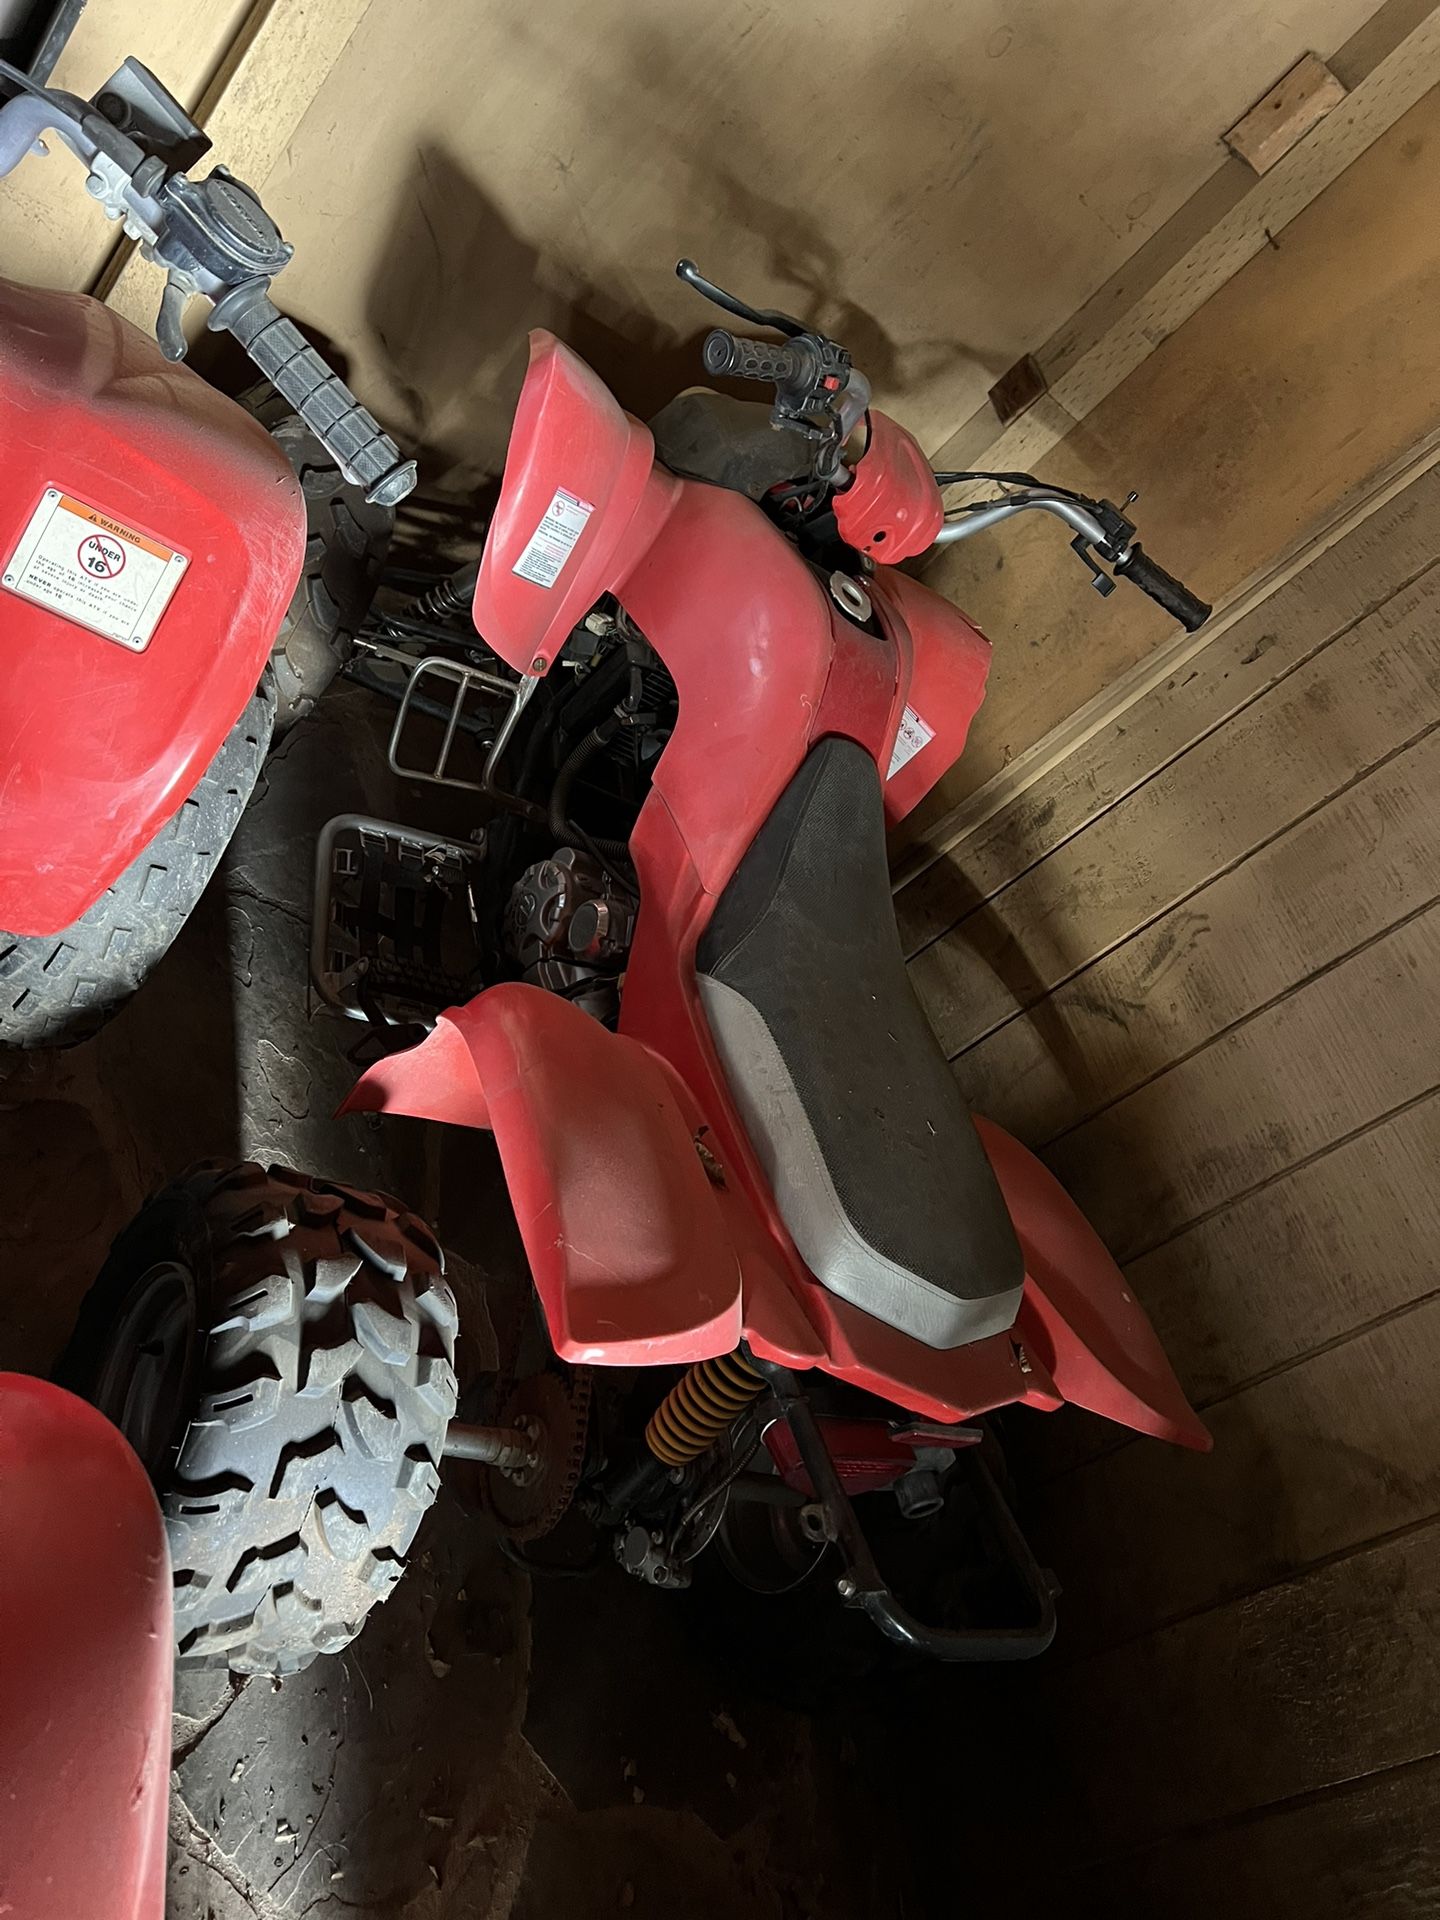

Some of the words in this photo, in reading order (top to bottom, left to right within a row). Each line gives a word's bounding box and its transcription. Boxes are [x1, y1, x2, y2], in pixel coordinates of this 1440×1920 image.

[100, 519, 140, 543] WARNING
[89, 541, 121, 562] UNDER
[38, 555, 65, 571] Operating
[88, 557, 106, 572] 16
[29, 574, 51, 587] NEVER
